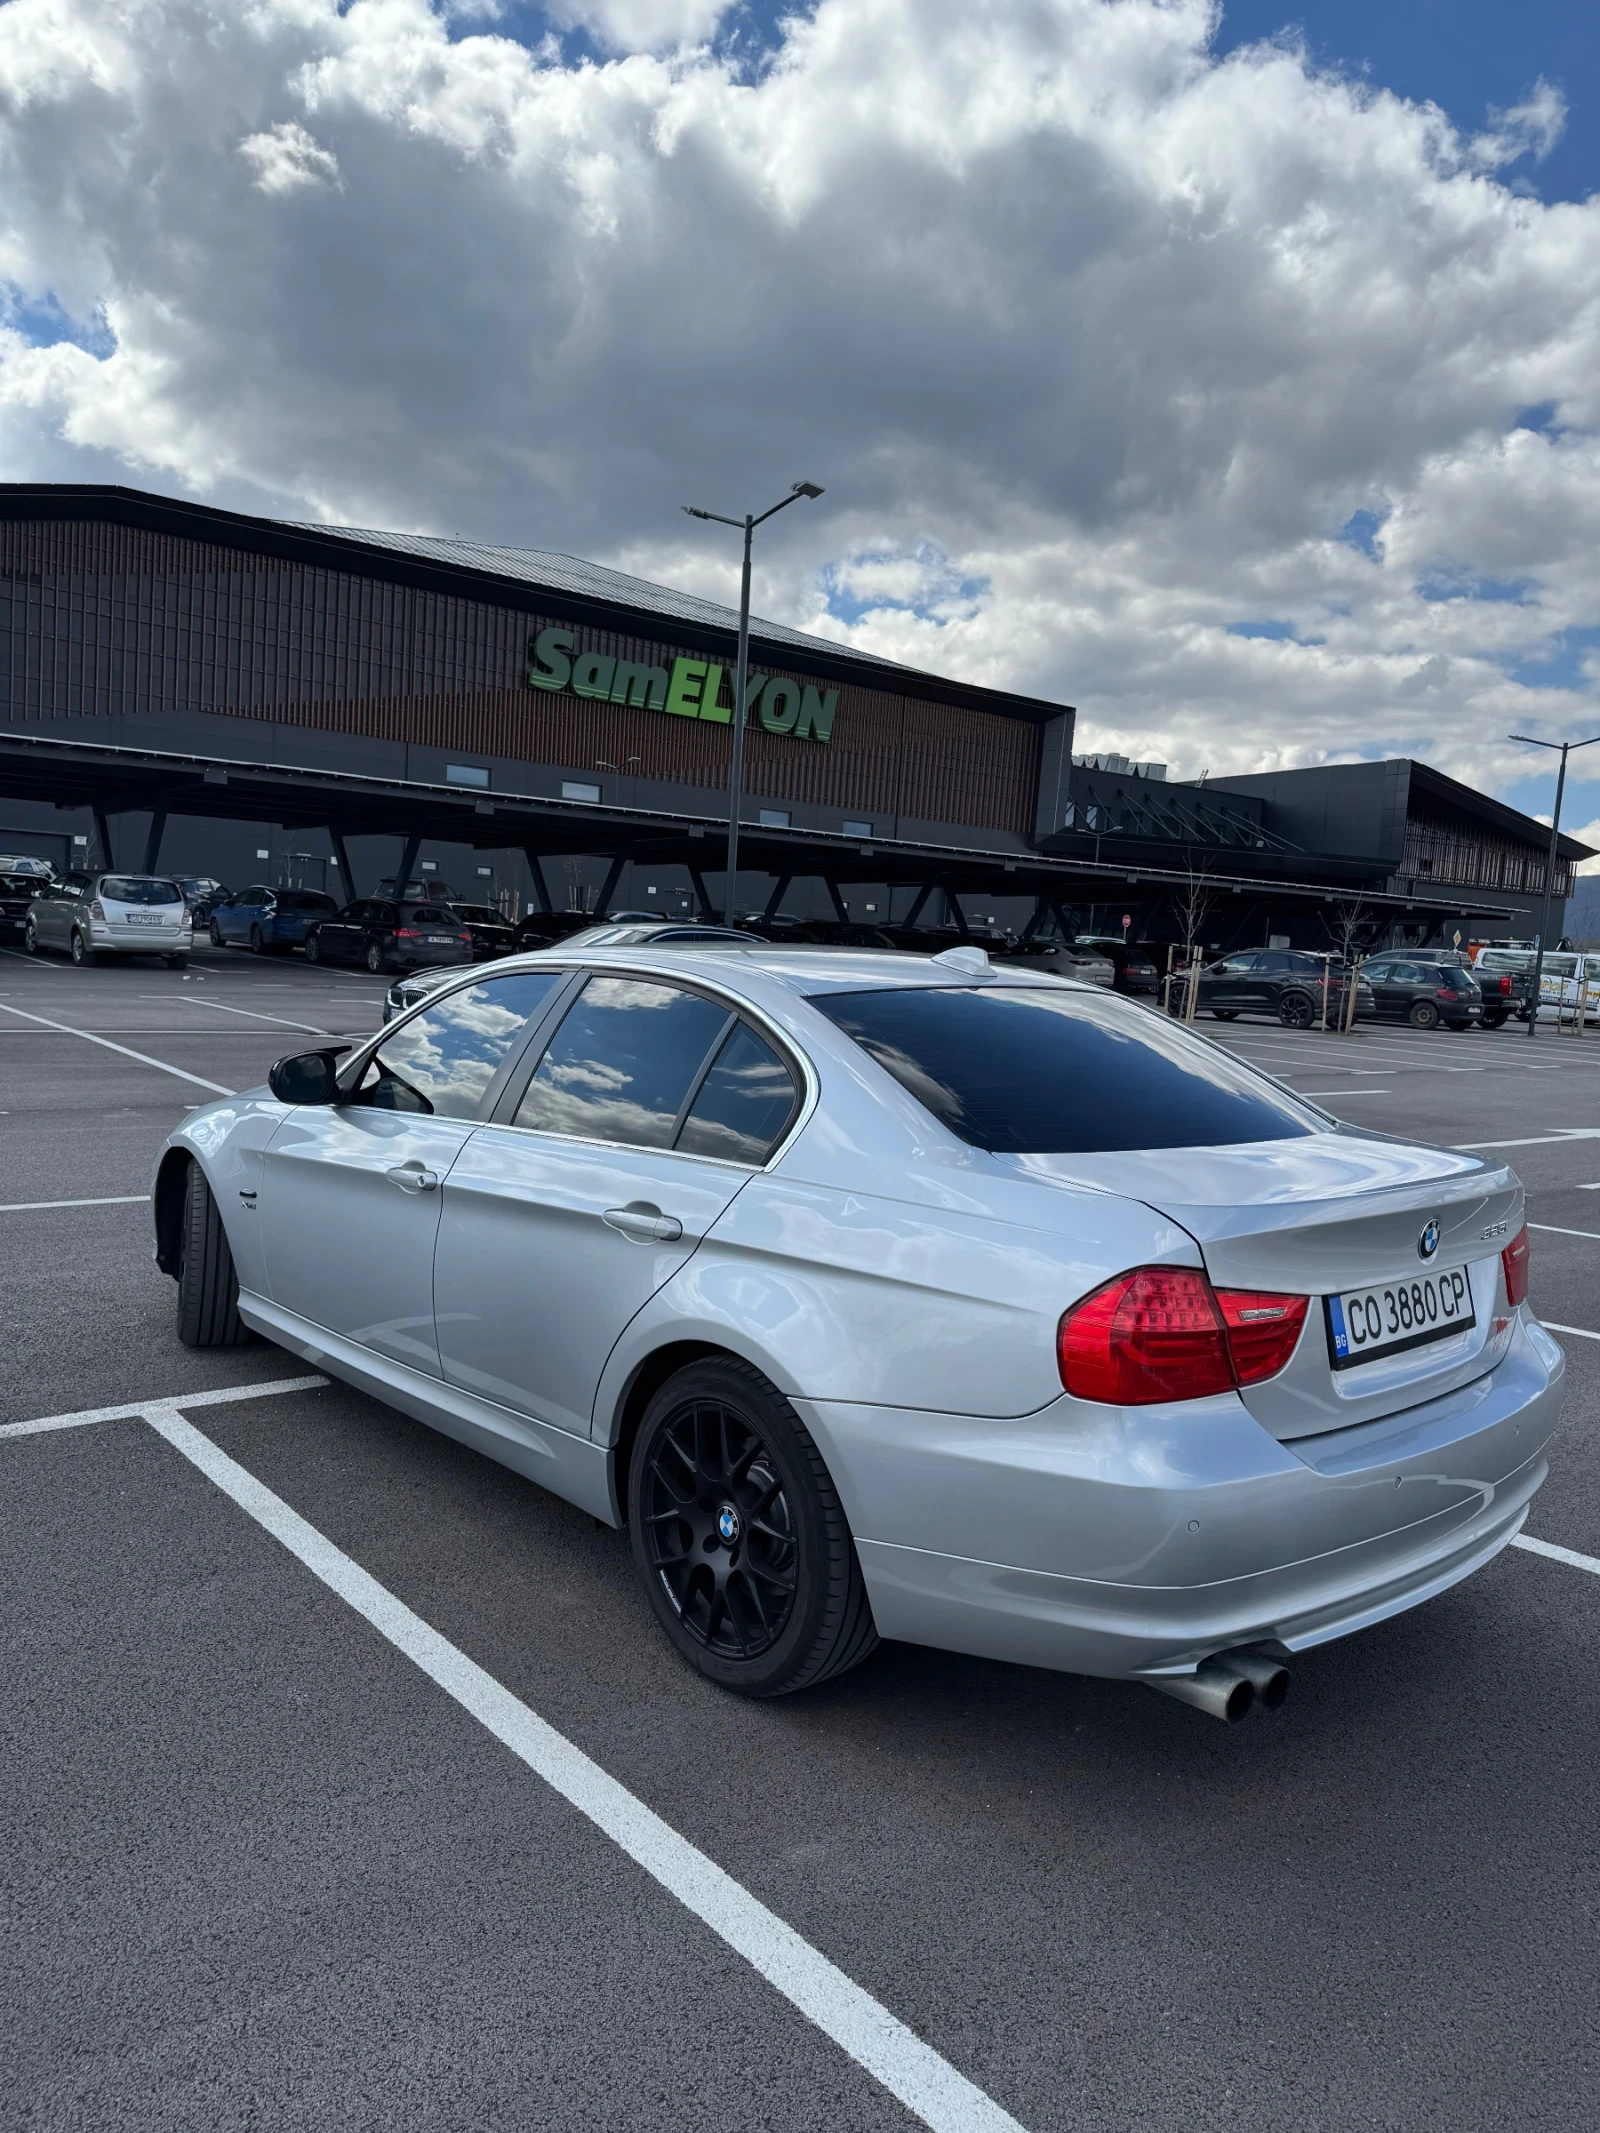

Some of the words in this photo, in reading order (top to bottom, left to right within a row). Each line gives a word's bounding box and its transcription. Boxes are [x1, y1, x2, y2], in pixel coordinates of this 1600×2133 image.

[528, 626, 839, 743] SamELYON
[1335, 1333, 1347, 1350] BG
[1348, 1294, 1382, 1344] CO
[1384, 1280, 1438, 1334] 3880
[1439, 1272, 1465, 1317] CP
